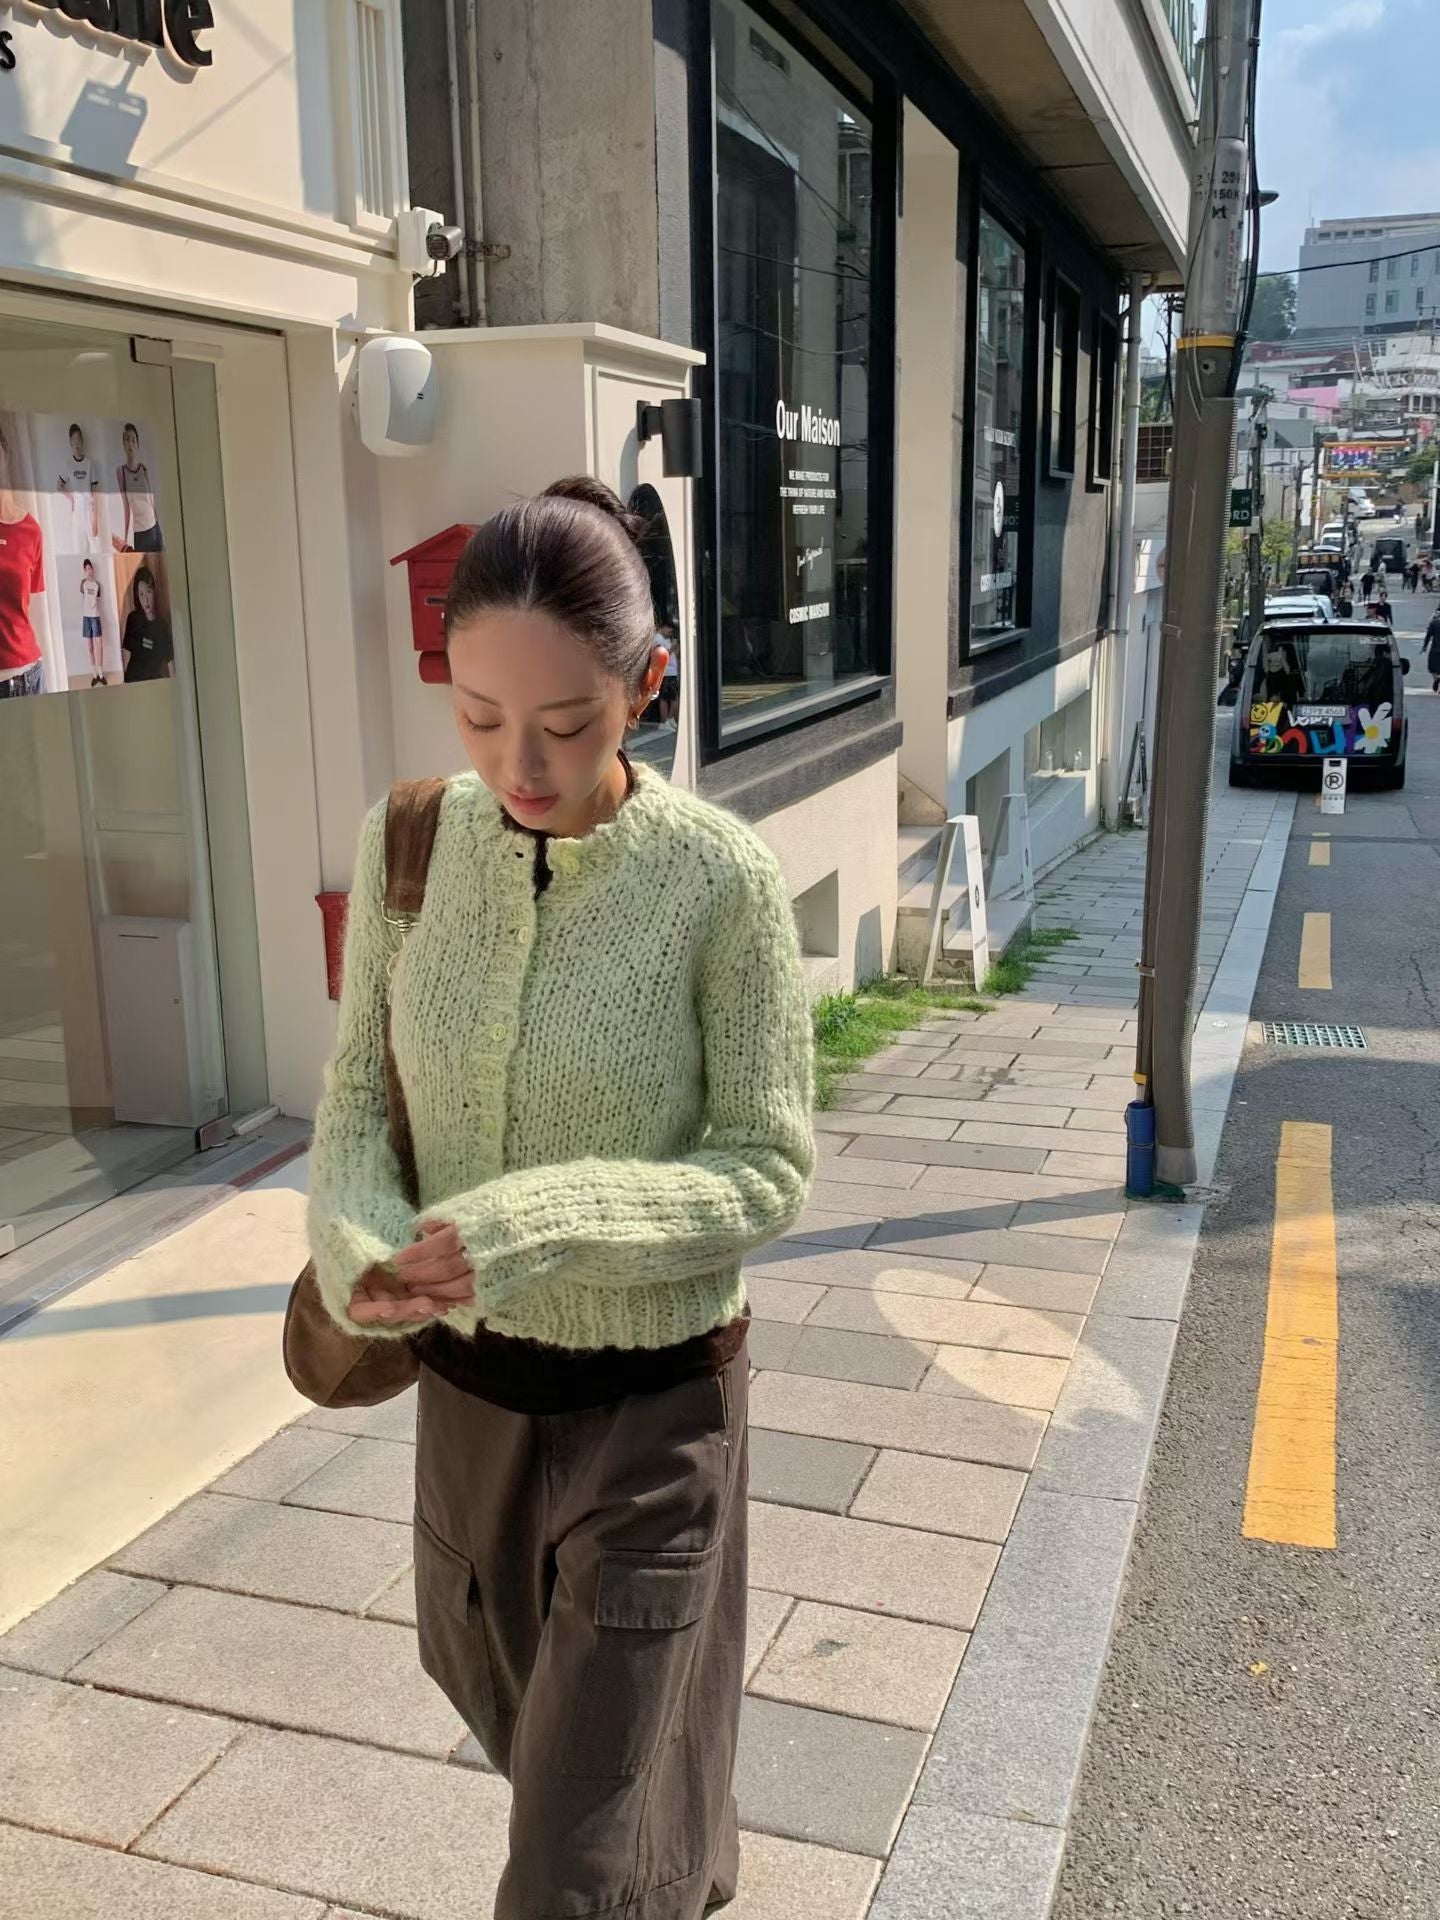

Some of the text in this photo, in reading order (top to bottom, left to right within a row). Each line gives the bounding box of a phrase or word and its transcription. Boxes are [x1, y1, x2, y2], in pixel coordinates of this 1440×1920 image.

[776, 400, 841, 447] Our Maison
[1231, 509, 1249, 521] RD
